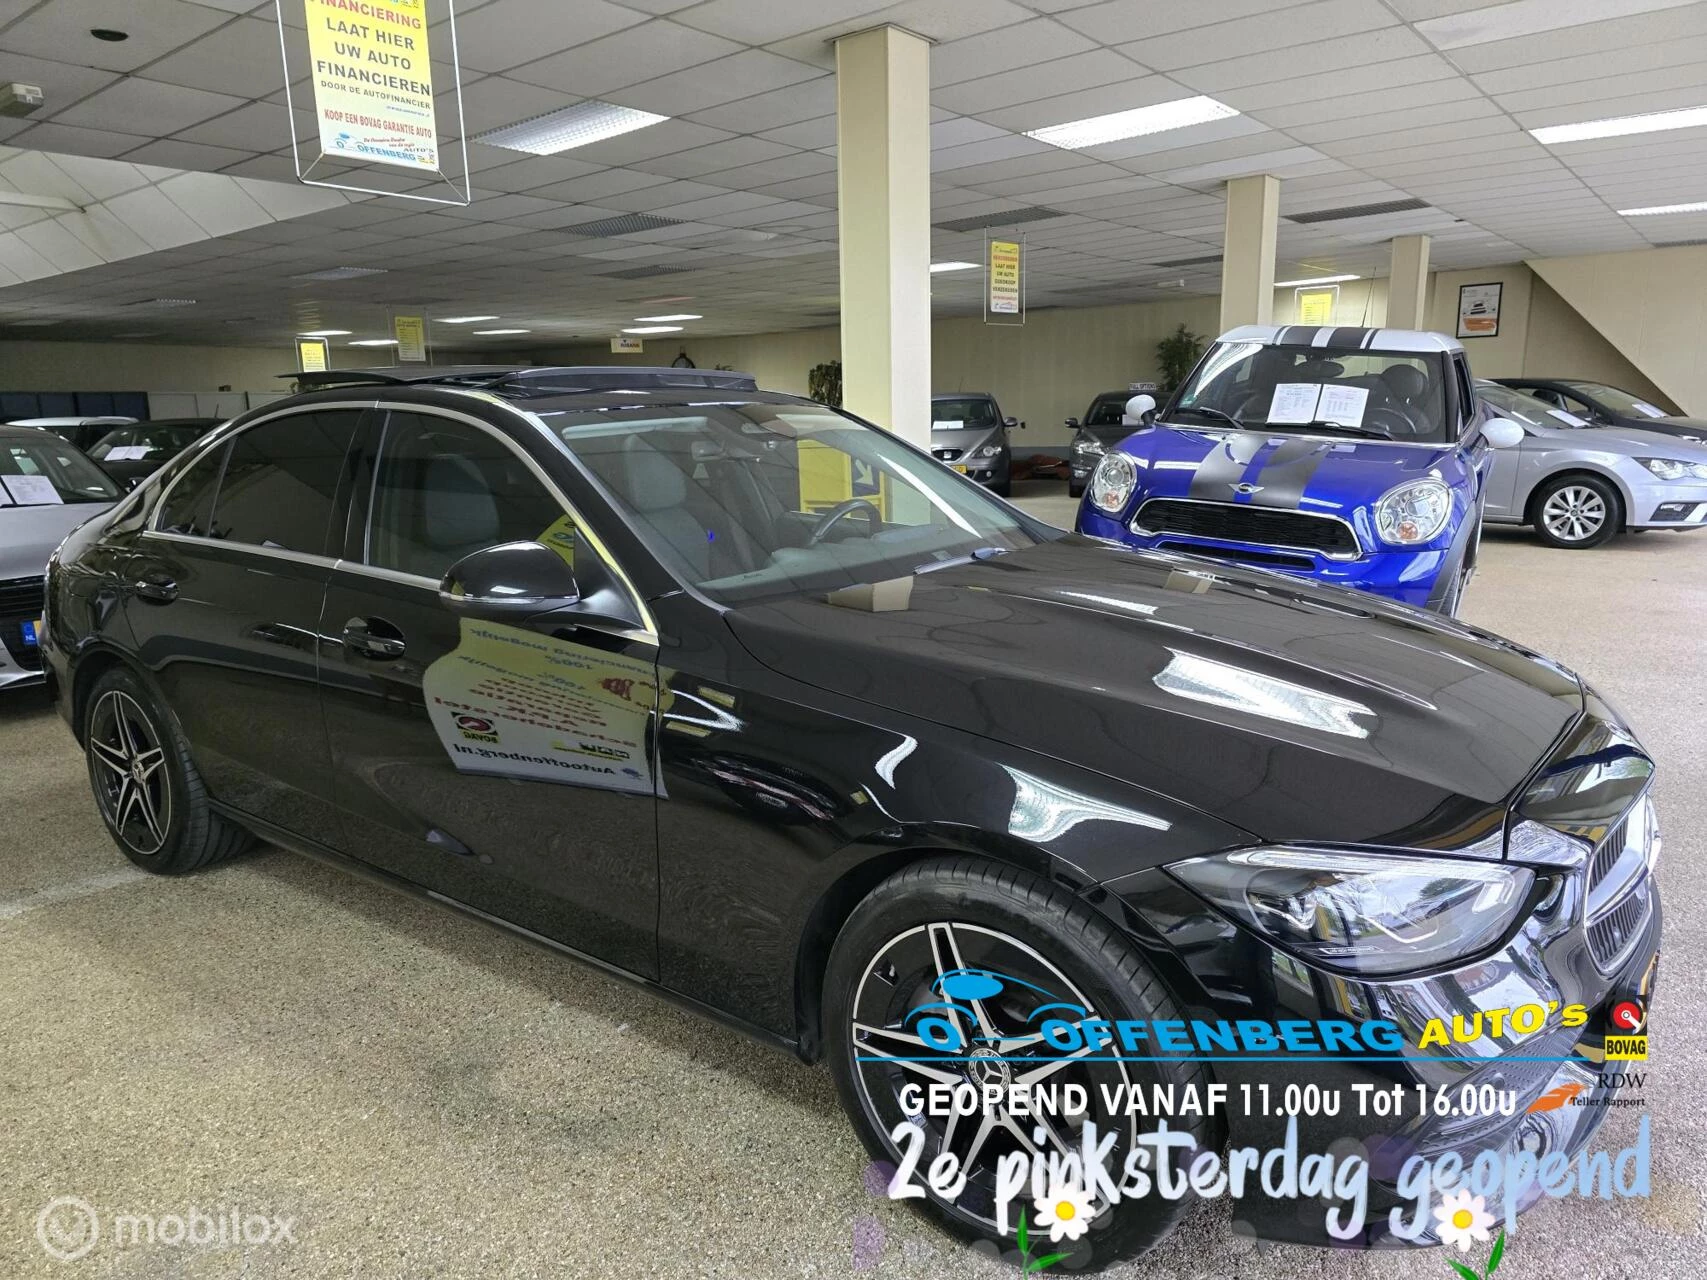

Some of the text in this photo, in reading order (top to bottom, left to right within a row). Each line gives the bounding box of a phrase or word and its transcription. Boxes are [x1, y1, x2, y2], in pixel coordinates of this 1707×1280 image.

[310, 0, 421, 29] NANCIERING
[326, 17, 415, 51] LAAT HIER
[334, 41, 411, 70] UW AUTO
[317, 60, 431, 97] FINANCIEREN
[320, 80, 431, 109] DOOR DE AUTOFINANCIER
[324, 109, 432, 139] KOOP EEN BOVAG GARANTIE AUTO
[357, 144, 417, 161] OFFENBERG
